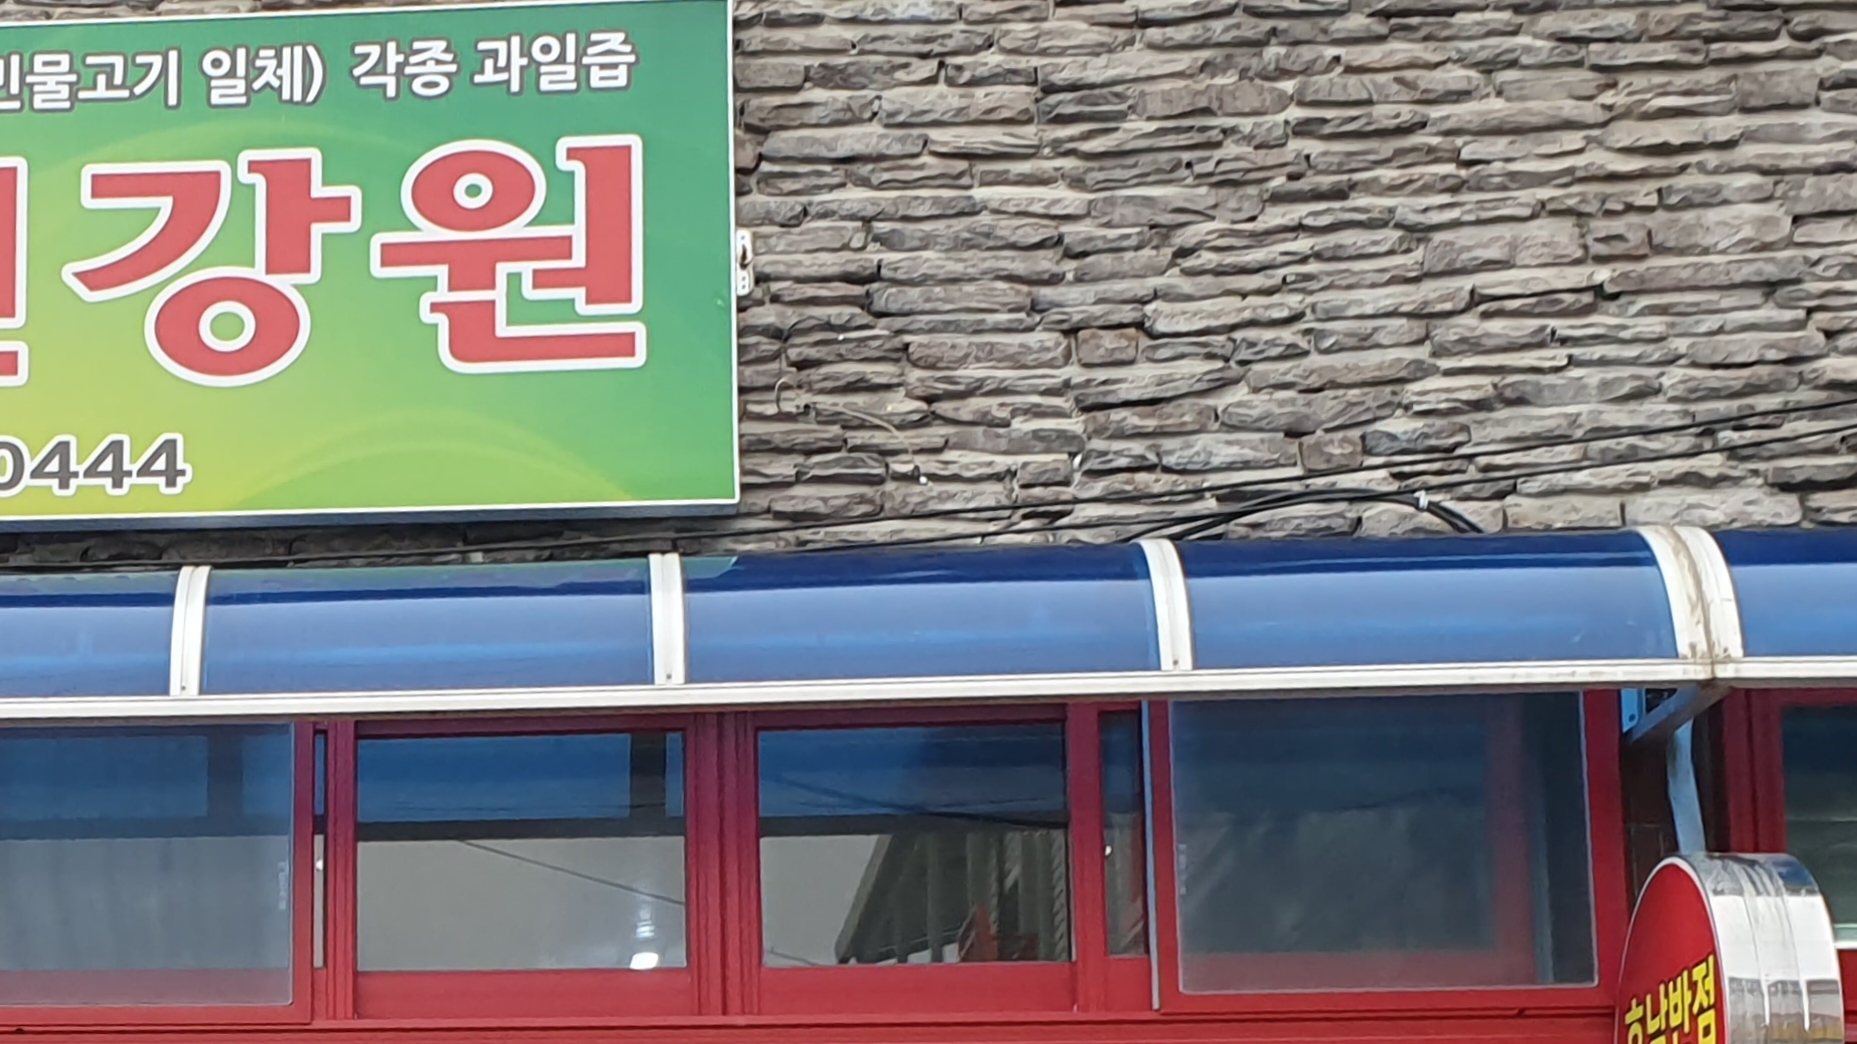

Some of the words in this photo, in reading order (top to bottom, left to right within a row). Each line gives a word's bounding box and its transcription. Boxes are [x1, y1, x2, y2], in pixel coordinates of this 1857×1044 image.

[201, 44, 325, 107] 일체)
[350, 40, 459, 101] 각종
[472, 30, 638, 94] 과일즙
